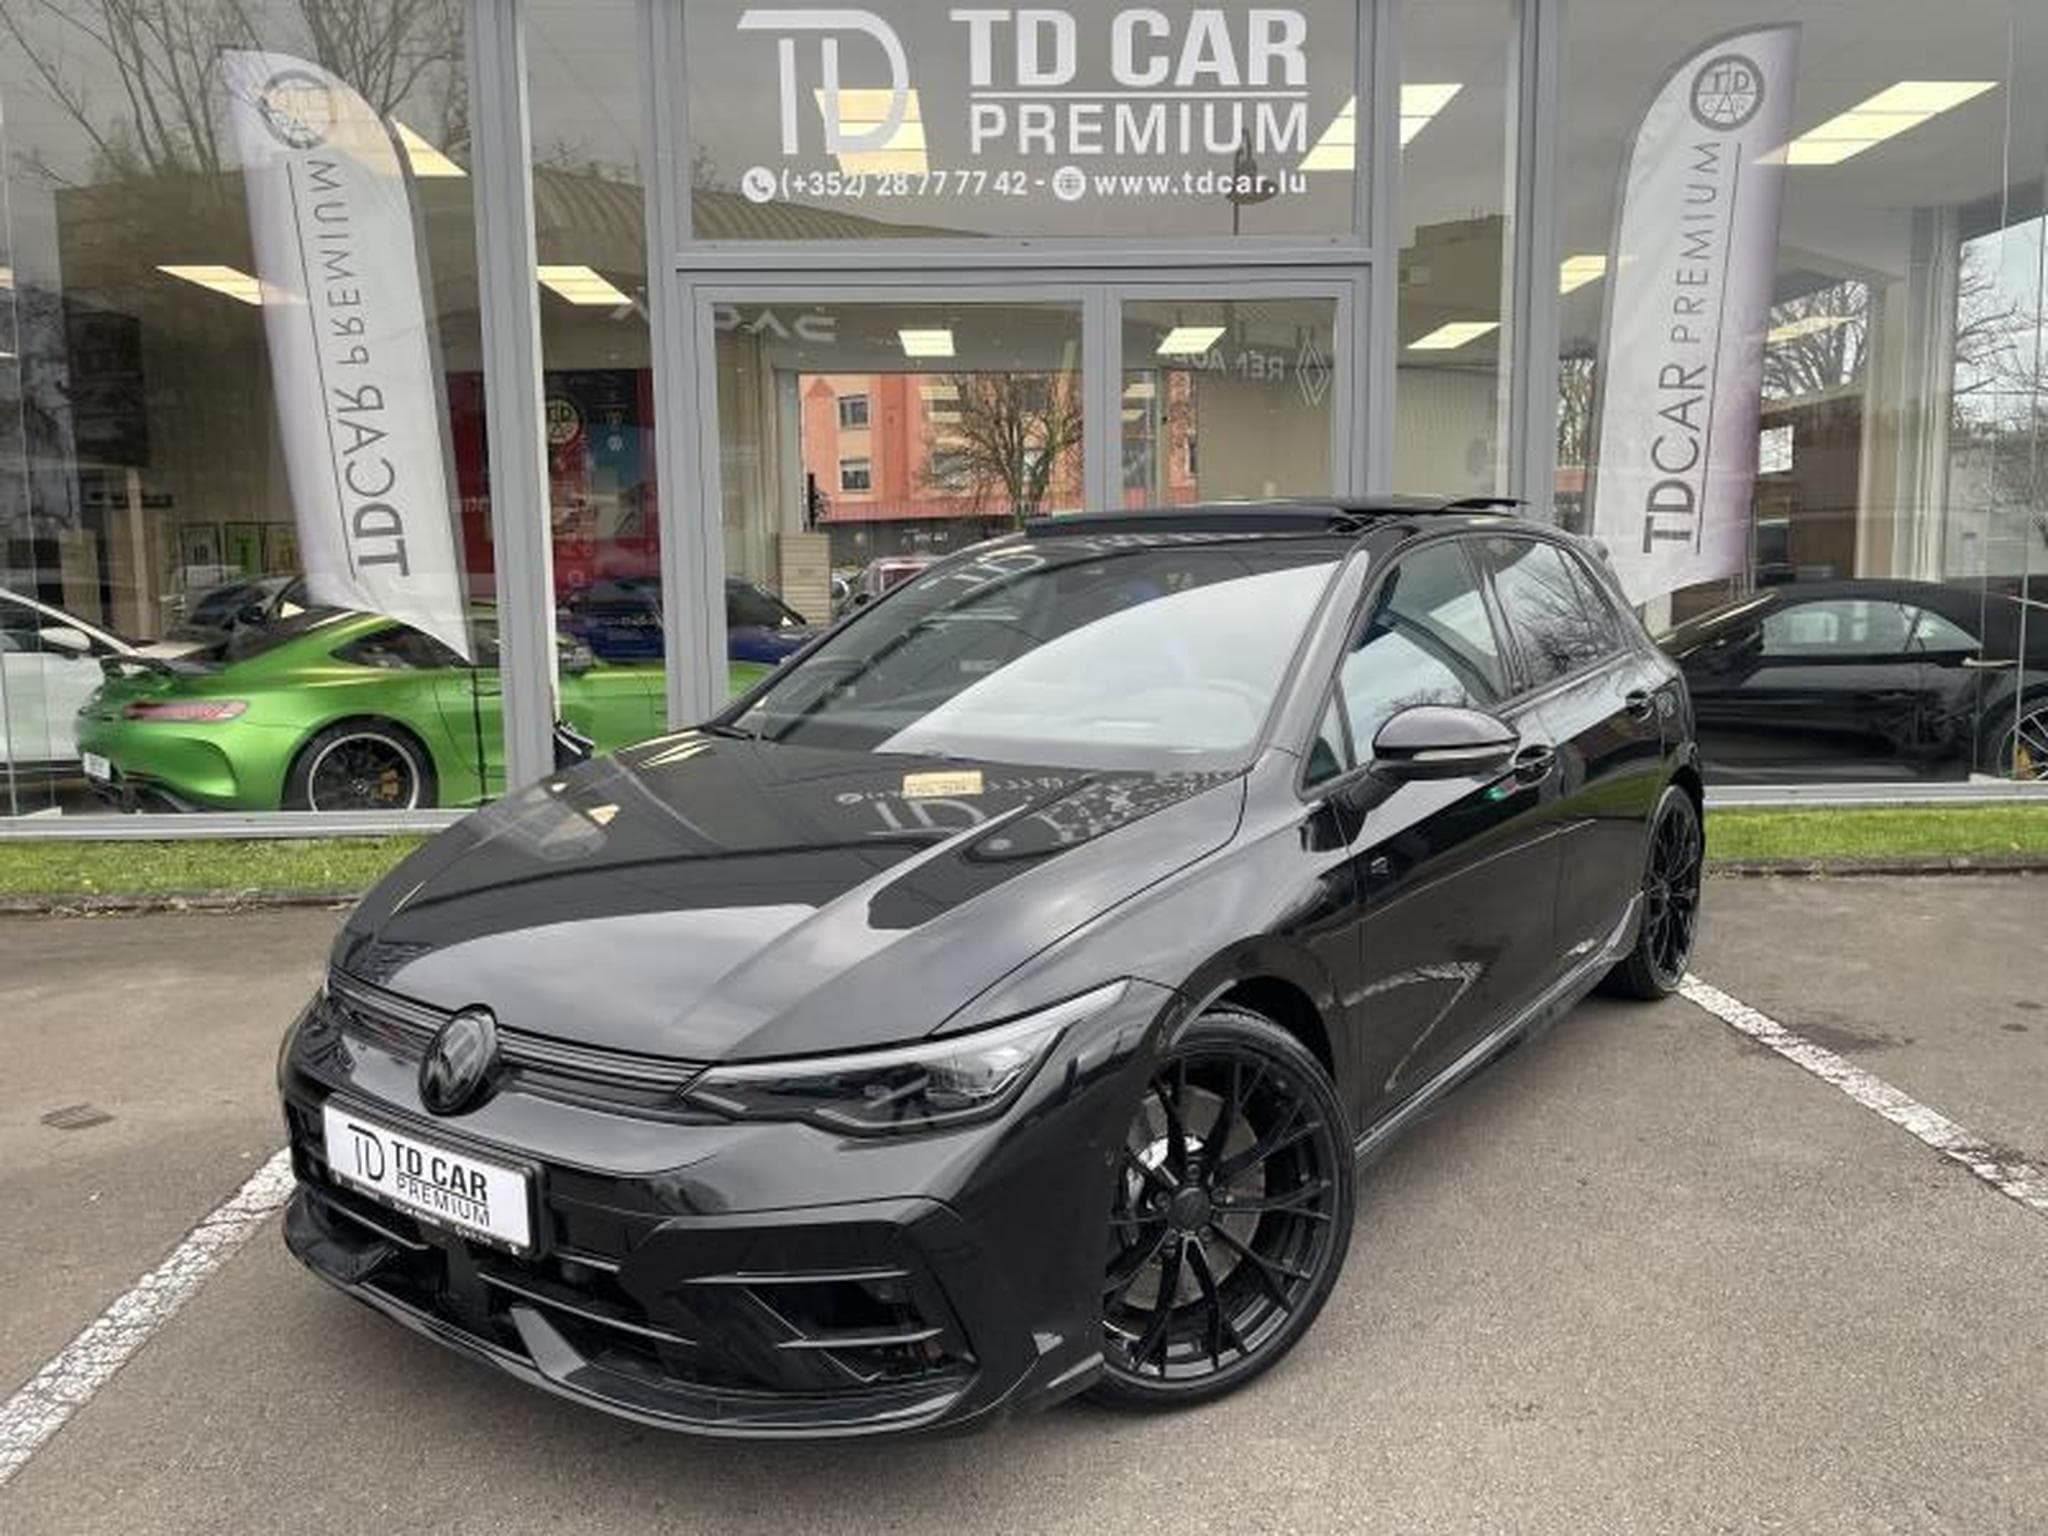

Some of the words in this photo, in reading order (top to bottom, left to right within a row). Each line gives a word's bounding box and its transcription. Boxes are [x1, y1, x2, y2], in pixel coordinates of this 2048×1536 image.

[950, 9, 1076, 86] TD
[1112, 9, 1307, 86] CAR
[970, 103, 1307, 154] PREMIUM
[782, 168, 867, 198] (+352)
[877, 173, 908, 195] 28
[917, 170, 948, 195] 77
[955, 170, 987, 195] 77
[994, 170, 1027, 195] 42
[1094, 170, 1307, 195] www.tdcar.lu
[1671, 141, 1721, 344] PREMIUM
[1643, 362, 1707, 554] TDCAR
[391, 1141, 422, 1176] TD
[431, 1158, 488, 1201] CAR
[397, 1172, 490, 1227] PREMIUM
